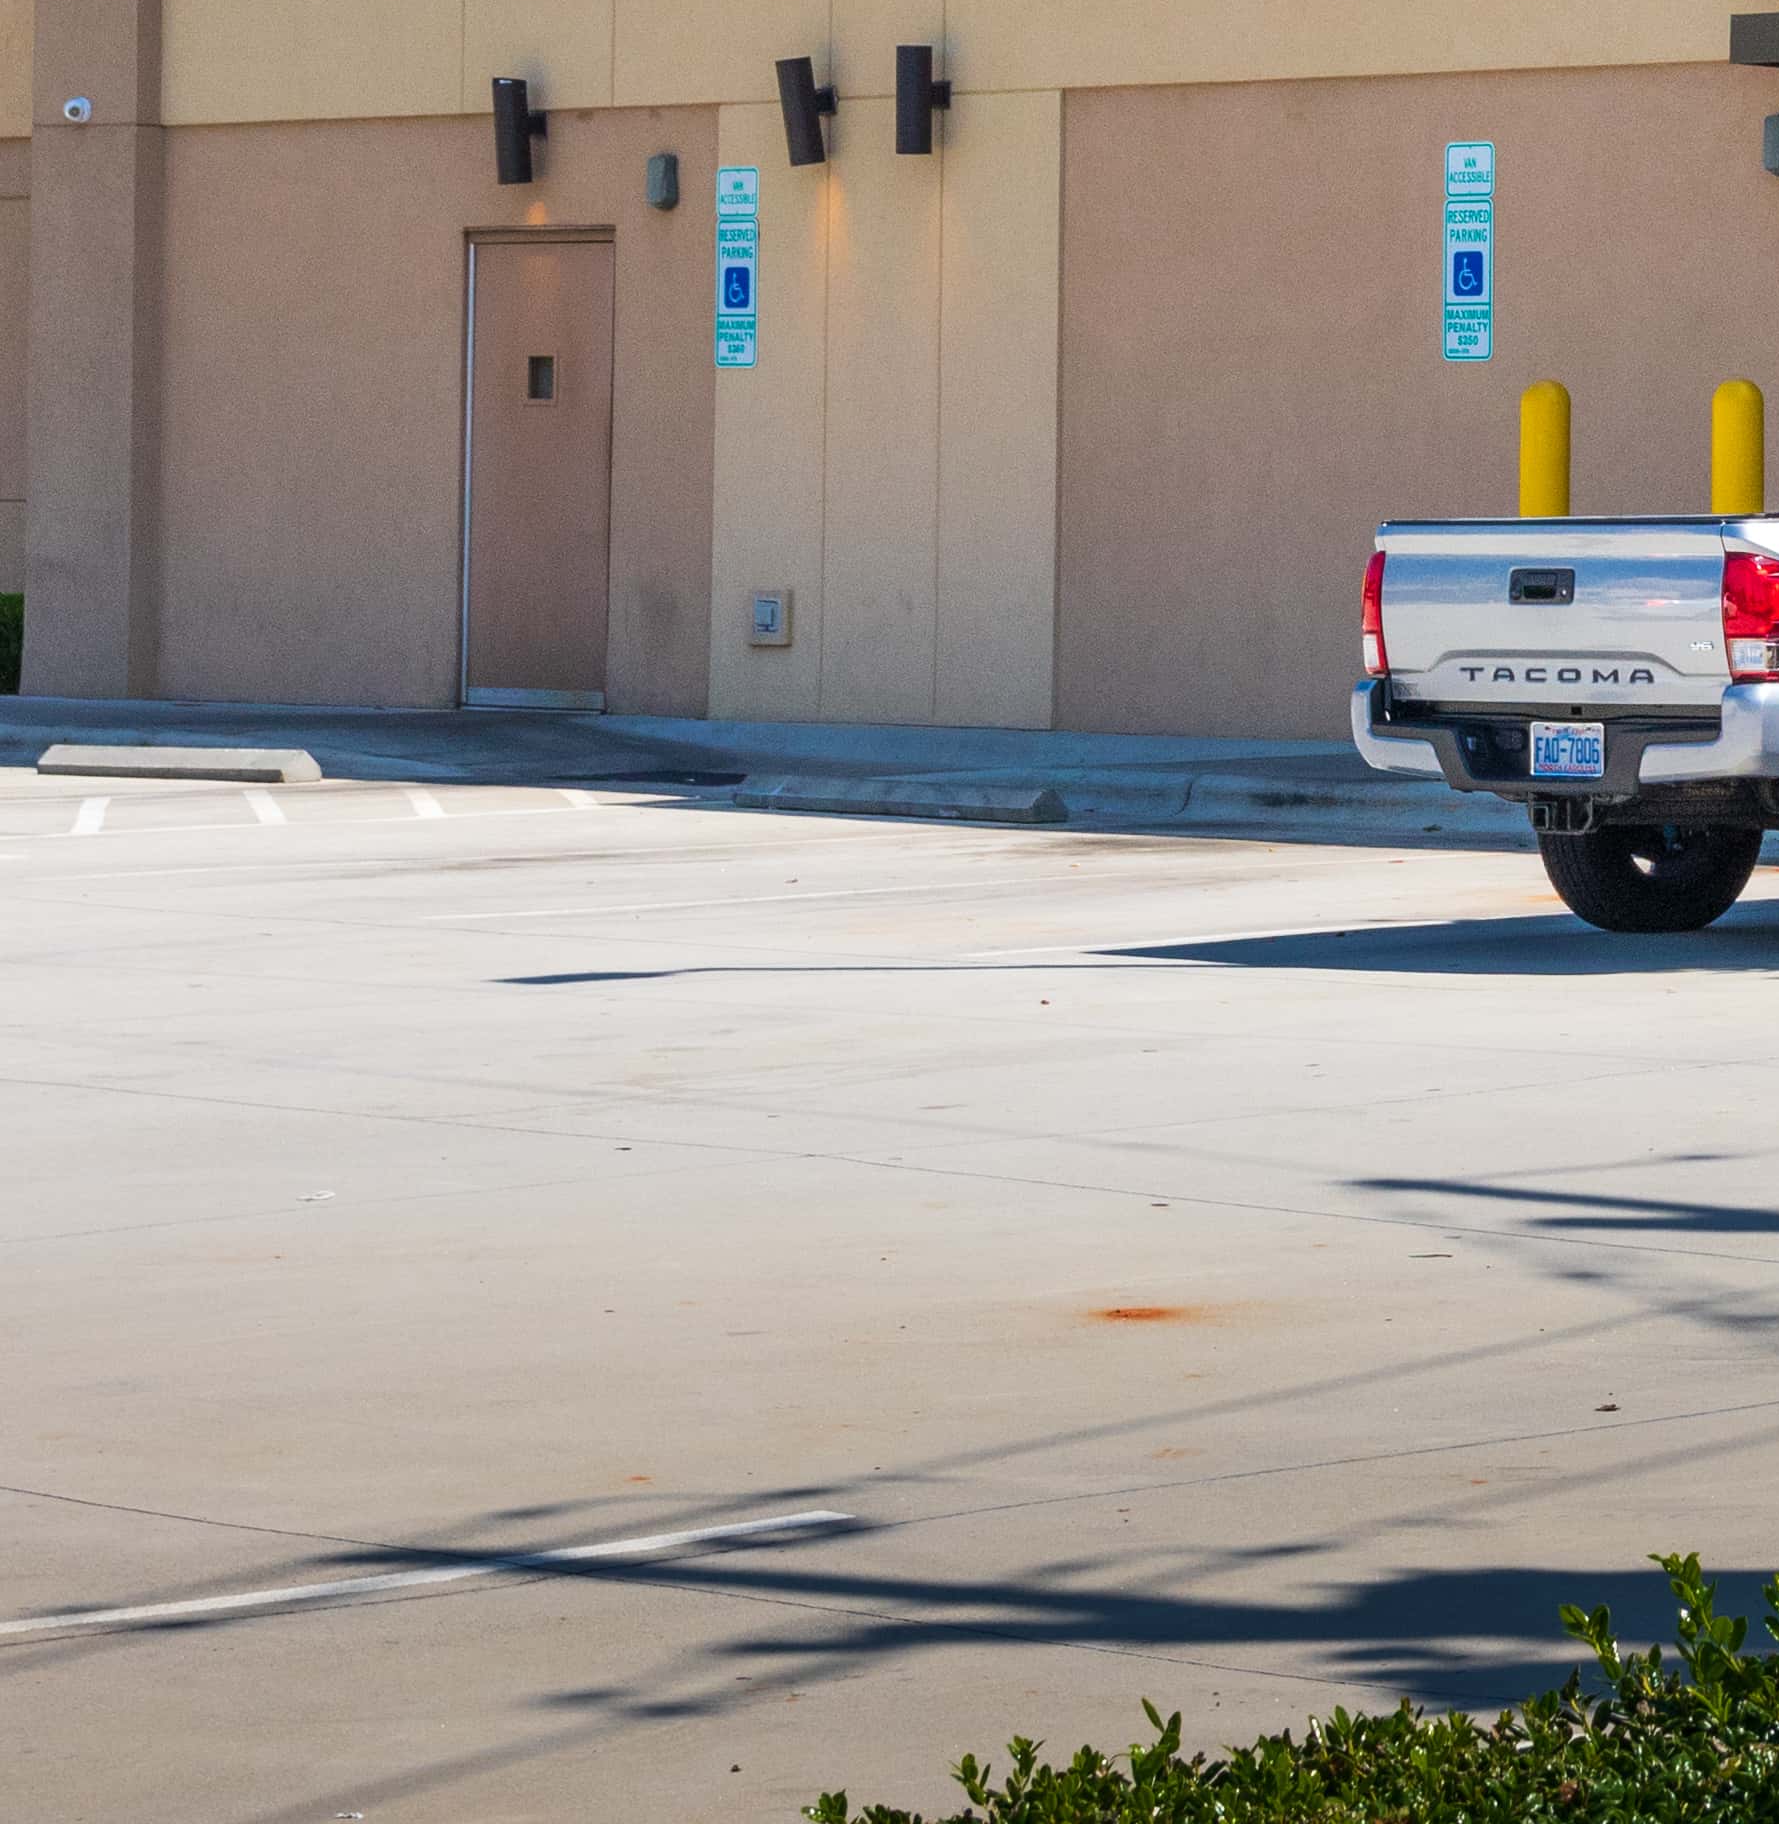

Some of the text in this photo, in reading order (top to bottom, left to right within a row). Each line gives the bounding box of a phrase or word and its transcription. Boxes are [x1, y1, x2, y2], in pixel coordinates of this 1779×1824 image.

[1464, 158, 1477, 168] VAN
[1449, 170, 1490, 184] ACCESSIBLE
[1448, 209, 1490, 224] RESERVED
[1449, 228, 1488, 243] PARKING
[721, 246, 753, 259] PARKING
[1447, 310, 1488, 320] MAXIMUM
[1447, 322, 1488, 333] PENALTY
[1459, 665, 1656, 685] TACOMA
